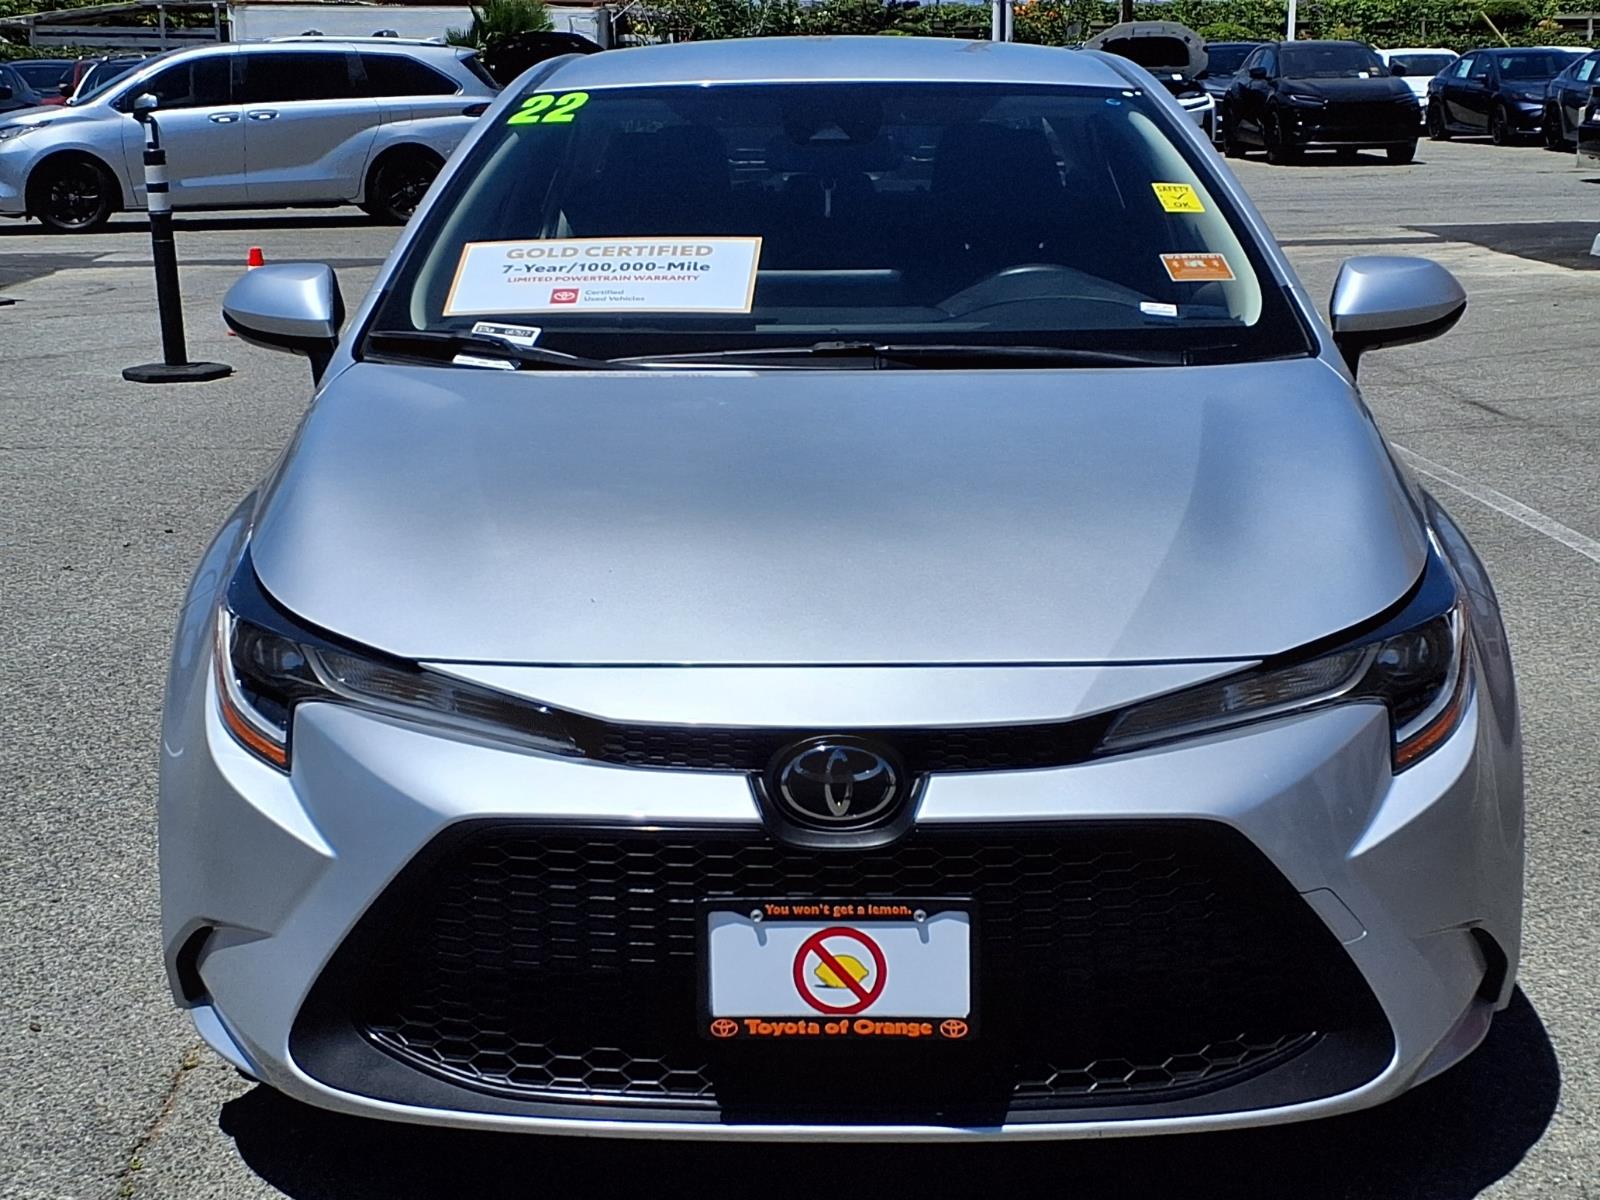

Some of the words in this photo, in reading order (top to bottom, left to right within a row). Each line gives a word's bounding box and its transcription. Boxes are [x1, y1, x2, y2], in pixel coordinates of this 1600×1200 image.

[506, 91, 590, 124] 22
[506, 247, 579, 260] GOLD
[585, 245, 714, 257] CERTIFIED
[502, 261, 711, 274] 7-Year/100,000-Mile
[555, 274, 631, 282] POWERTRAIN
[764, 903, 790, 915] You
[792, 903, 830, 915] won't
[833, 904, 854, 918] get
[857, 905, 865, 915] a
[868, 904, 912, 915] lemon.
[744, 1019, 820, 1036] Toyota
[824, 1019, 849, 1035] of
[853, 1019, 932, 1037] Orange
